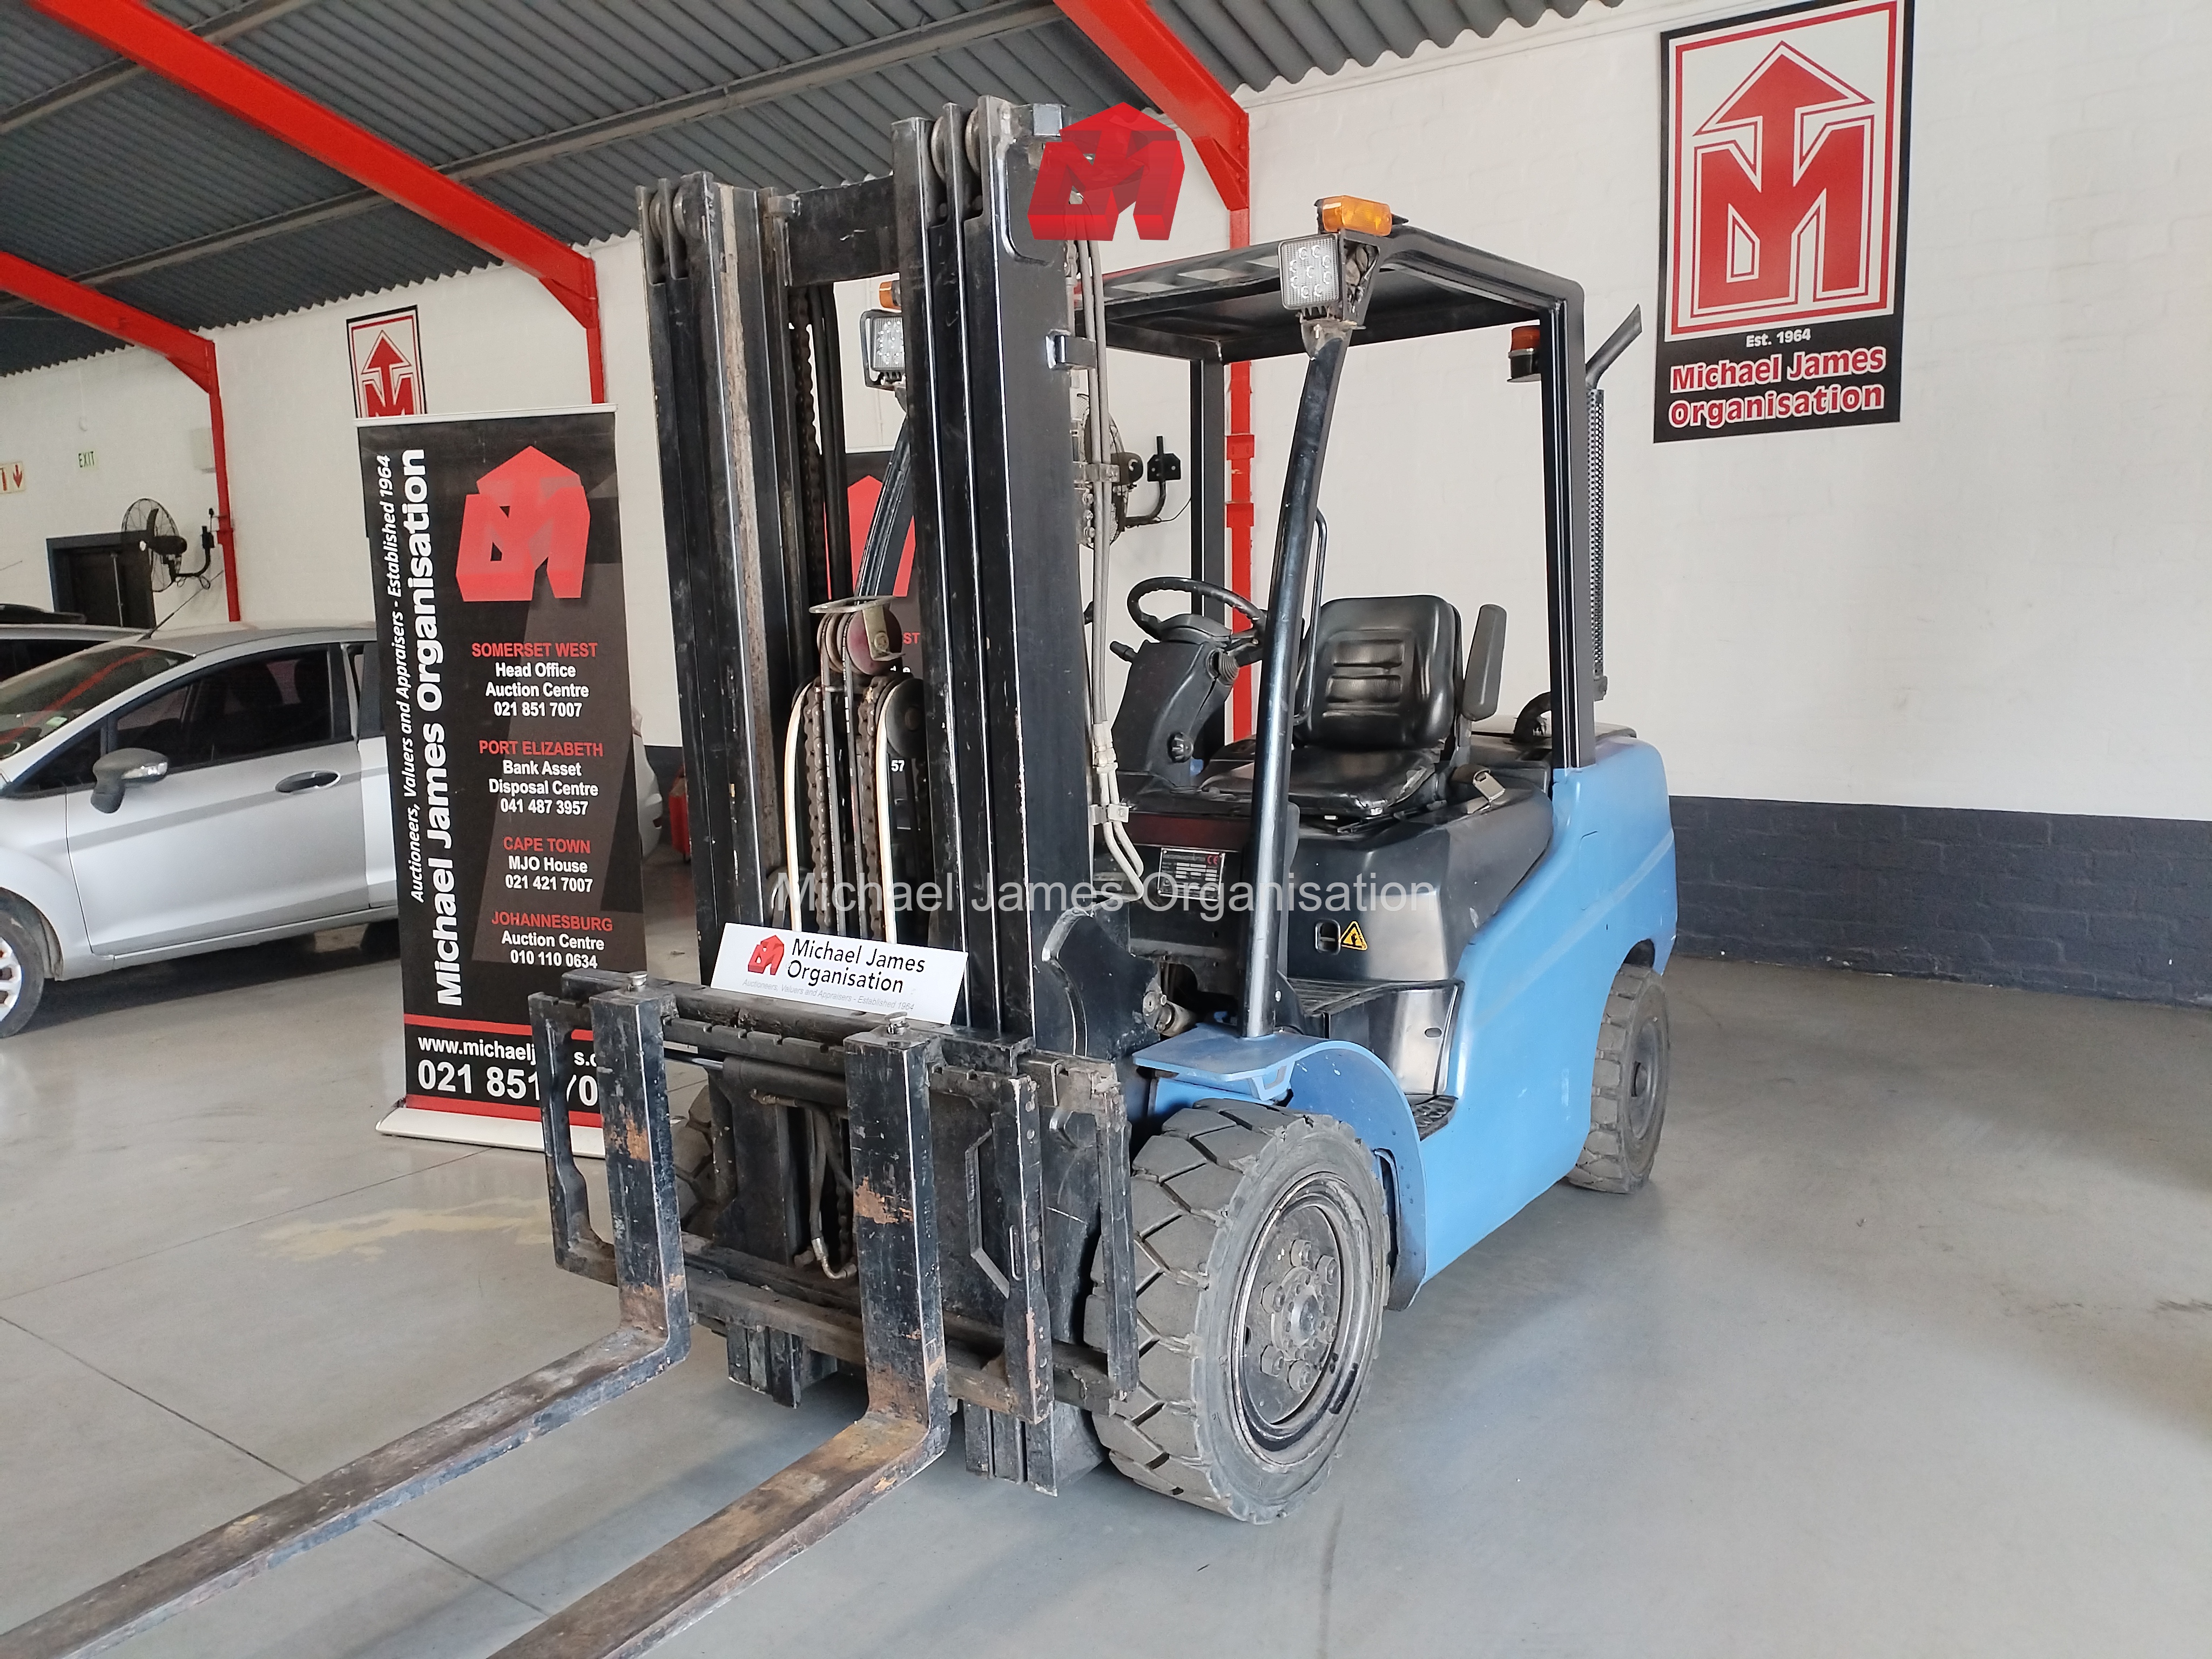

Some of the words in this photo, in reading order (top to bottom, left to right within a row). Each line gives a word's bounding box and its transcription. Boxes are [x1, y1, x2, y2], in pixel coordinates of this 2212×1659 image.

[1746, 335, 1772, 347] Est.
[1777, 328, 1811, 343] 1964
[1670, 354, 1782, 393] Michael
[1787, 346, 1886, 381] James
[1669, 383, 1885, 429] Organisation
[78, 451, 95, 468] EXIT
[376, 454, 393, 496] 1964
[380, 501, 401, 597] Established
[402, 449, 444, 712] Organisation
[903, 632, 920, 644] ST
[392, 611, 412, 699] Appraisers
[471, 642, 552, 658] SOMERSET
[555, 642, 598, 658] WEST
[495, 662, 531, 677] Head
[535, 662, 576, 677] Office
[485, 682, 539, 697] Auction
[543, 682, 590, 698] Centre
[396, 700, 413, 734] and
[494, 702, 517, 717] 021
[522, 702, 546, 717] 851
[550, 702, 583, 717] 7007
[479, 739, 518, 755] PORT
[522, 741, 603, 757] ELIZABETH
[401, 737, 417, 797] Valuers
[503, 759, 539, 775] Bank
[541, 760, 582, 776] Asset
[891, 760, 905, 772] 57
[423, 723, 452, 849] James
[488, 778, 549, 797] Disposal
[552, 780, 599, 796] Centre
[500, 798, 524, 813] 041
[528, 799, 552, 814] 487
[556, 799, 589, 815] 3957
[407, 804, 424, 903] Auctioneers,
[503, 837, 543, 852] CAPE
[547, 838, 591, 854] TOWN
[508, 855, 540, 871] MJO
[544, 857, 588, 873] House
[505, 874, 529, 889] 021
[532, 875, 557, 891] 421
[561, 876, 594, 892] 7007
[491, 911, 613, 932] JOHANNESBURG
[428, 858, 462, 1006] Michael
[501, 930, 555, 947] Auction
[559, 933, 605, 950] Centre
[510, 949, 535, 965] 010
[538, 951, 562, 966] 110
[565, 953, 598, 969] 0634
[792, 939, 862, 963] Michael
[866, 948, 925, 973] James
[788, 960, 903, 993] Organisation
[743, 979, 778, 992] Auctioneers,
[781, 984, 804, 994] Valuers
[818, 990, 853, 1002] Appraisers
[858, 996, 896, 1008] Established
[898, 1002, 915, 1010] 1964
[418, 1059, 472, 1094] 021
[487, 1066, 540, 1101] 851
